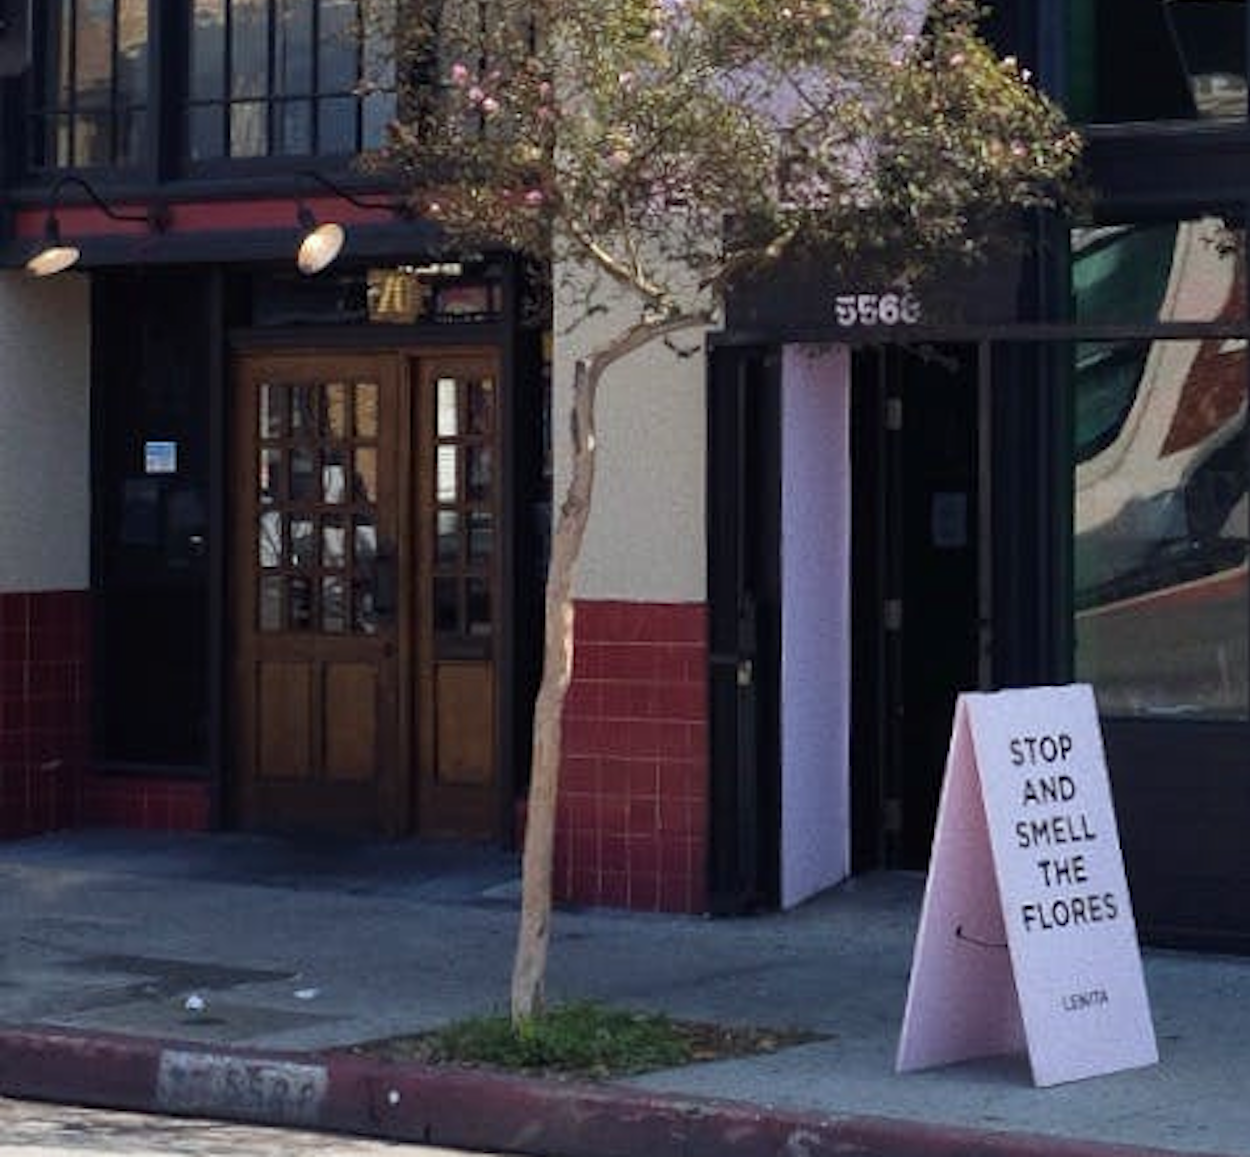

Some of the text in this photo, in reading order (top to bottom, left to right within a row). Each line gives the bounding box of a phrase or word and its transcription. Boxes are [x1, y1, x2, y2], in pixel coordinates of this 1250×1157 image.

[1010, 733, 1073, 767] STOP
[1022, 775, 1077, 806] AND
[1015, 813, 1098, 849] SMELL
[1036, 854, 1089, 888] THE
[1021, 892, 1119, 932] FLORES
